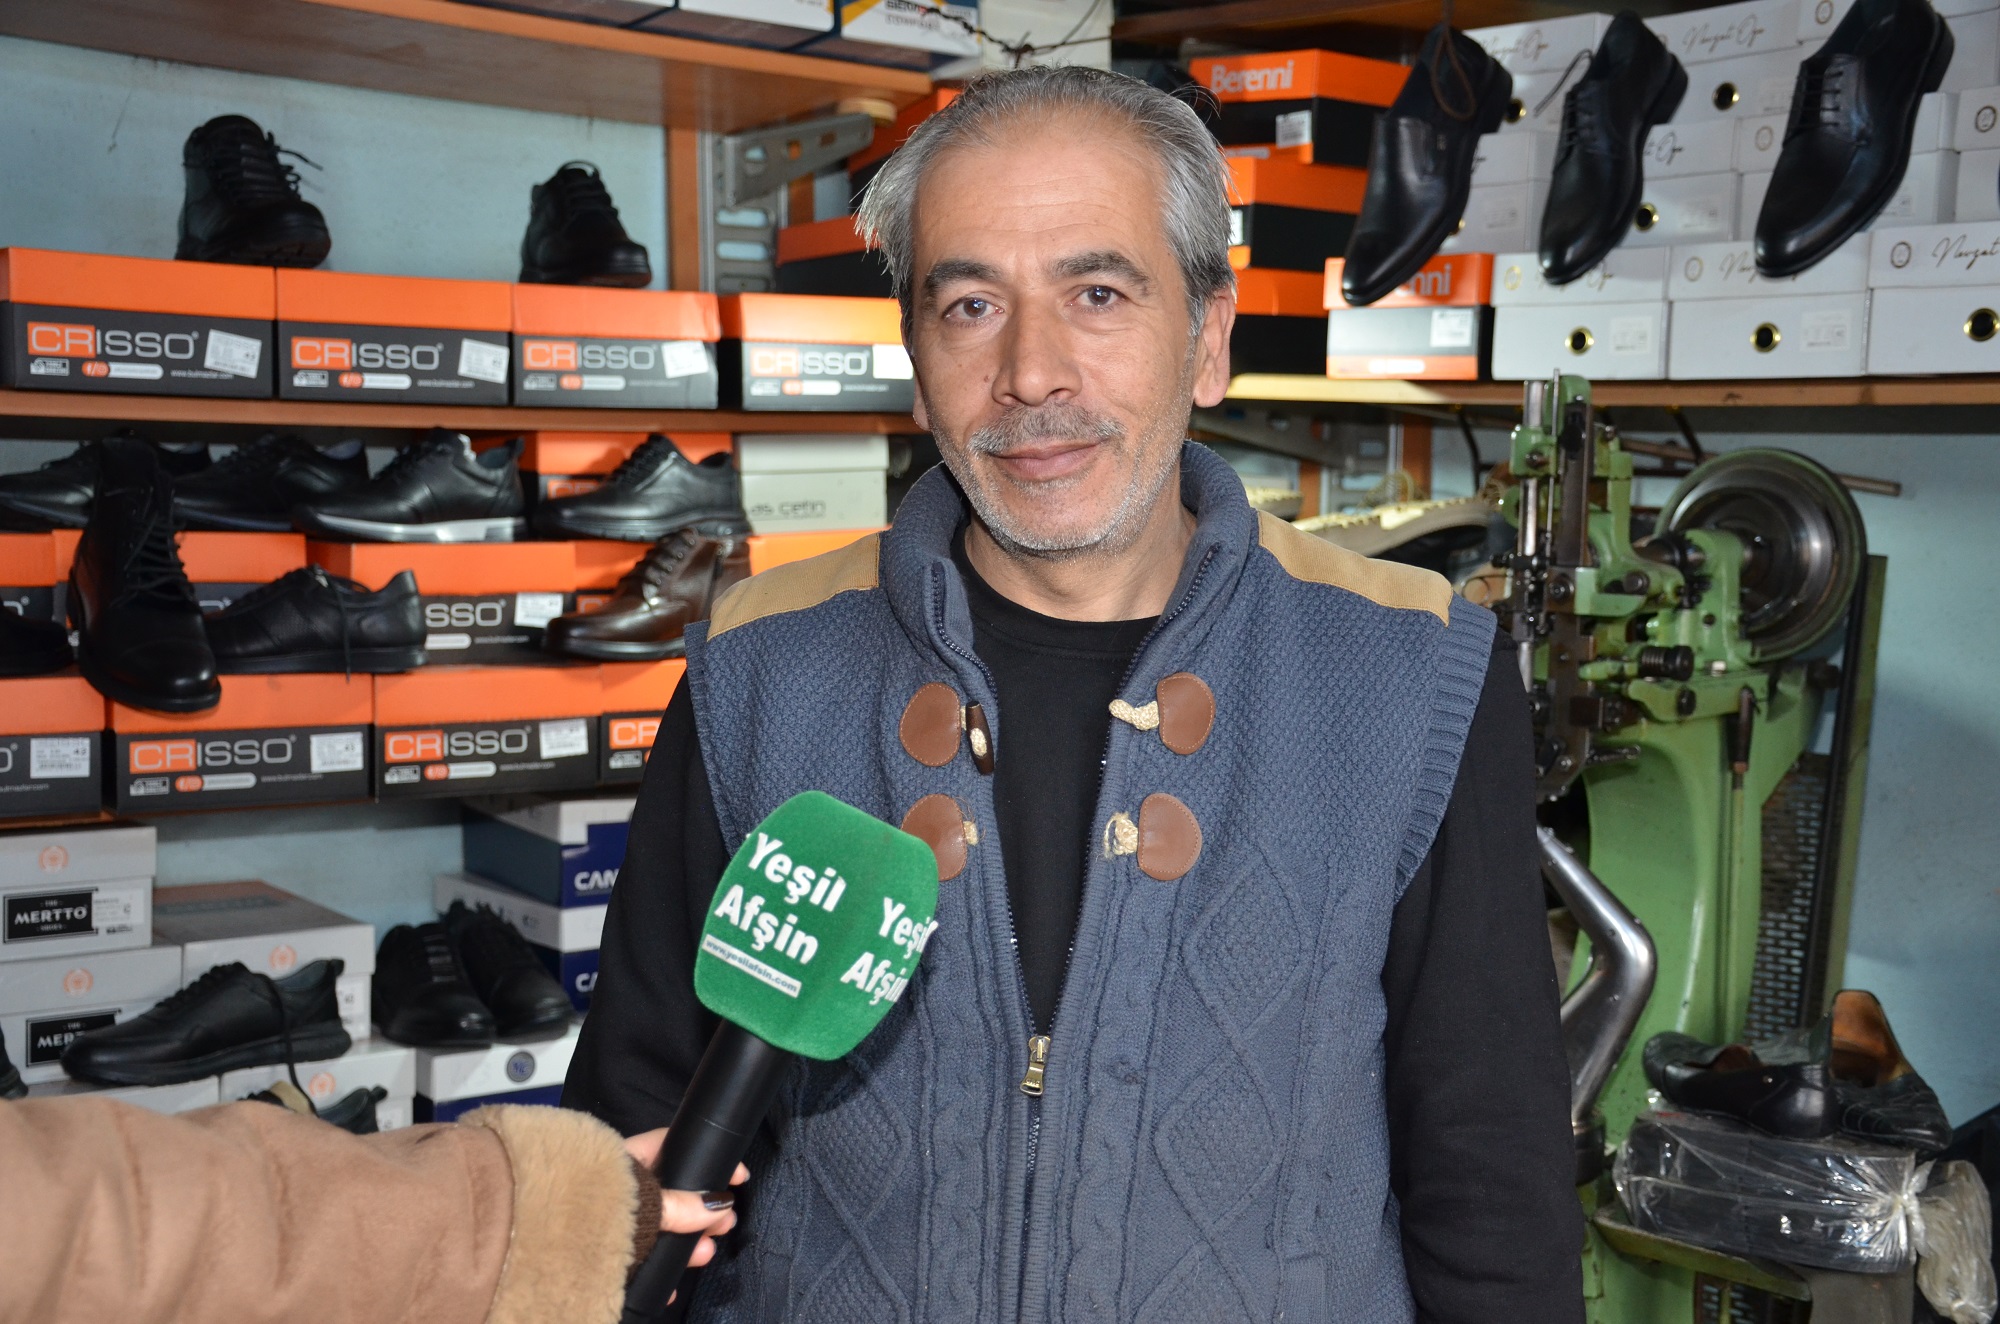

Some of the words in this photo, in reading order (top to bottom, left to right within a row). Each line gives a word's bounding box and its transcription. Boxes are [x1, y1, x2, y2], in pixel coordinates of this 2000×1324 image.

[1210, 60, 1294, 94] Berenni
[31, 326, 194, 359] CRISSO
[295, 341, 439, 370] CRISSO
[526, 343, 655, 370] CRISSO
[753, 351, 868, 375] CRISSO
[425, 602, 503, 627] SSO
[134, 738, 292, 769] CRISSO
[389, 729, 528, 759] CRISSO
[748, 832, 847, 912] Yeşil
[14, 906, 88, 926] MERTTO
[714, 884, 819, 965] Afşin
[879, 896, 939, 959] Yeşil
[705, 939, 798, 992] www.yesilafsin.com
